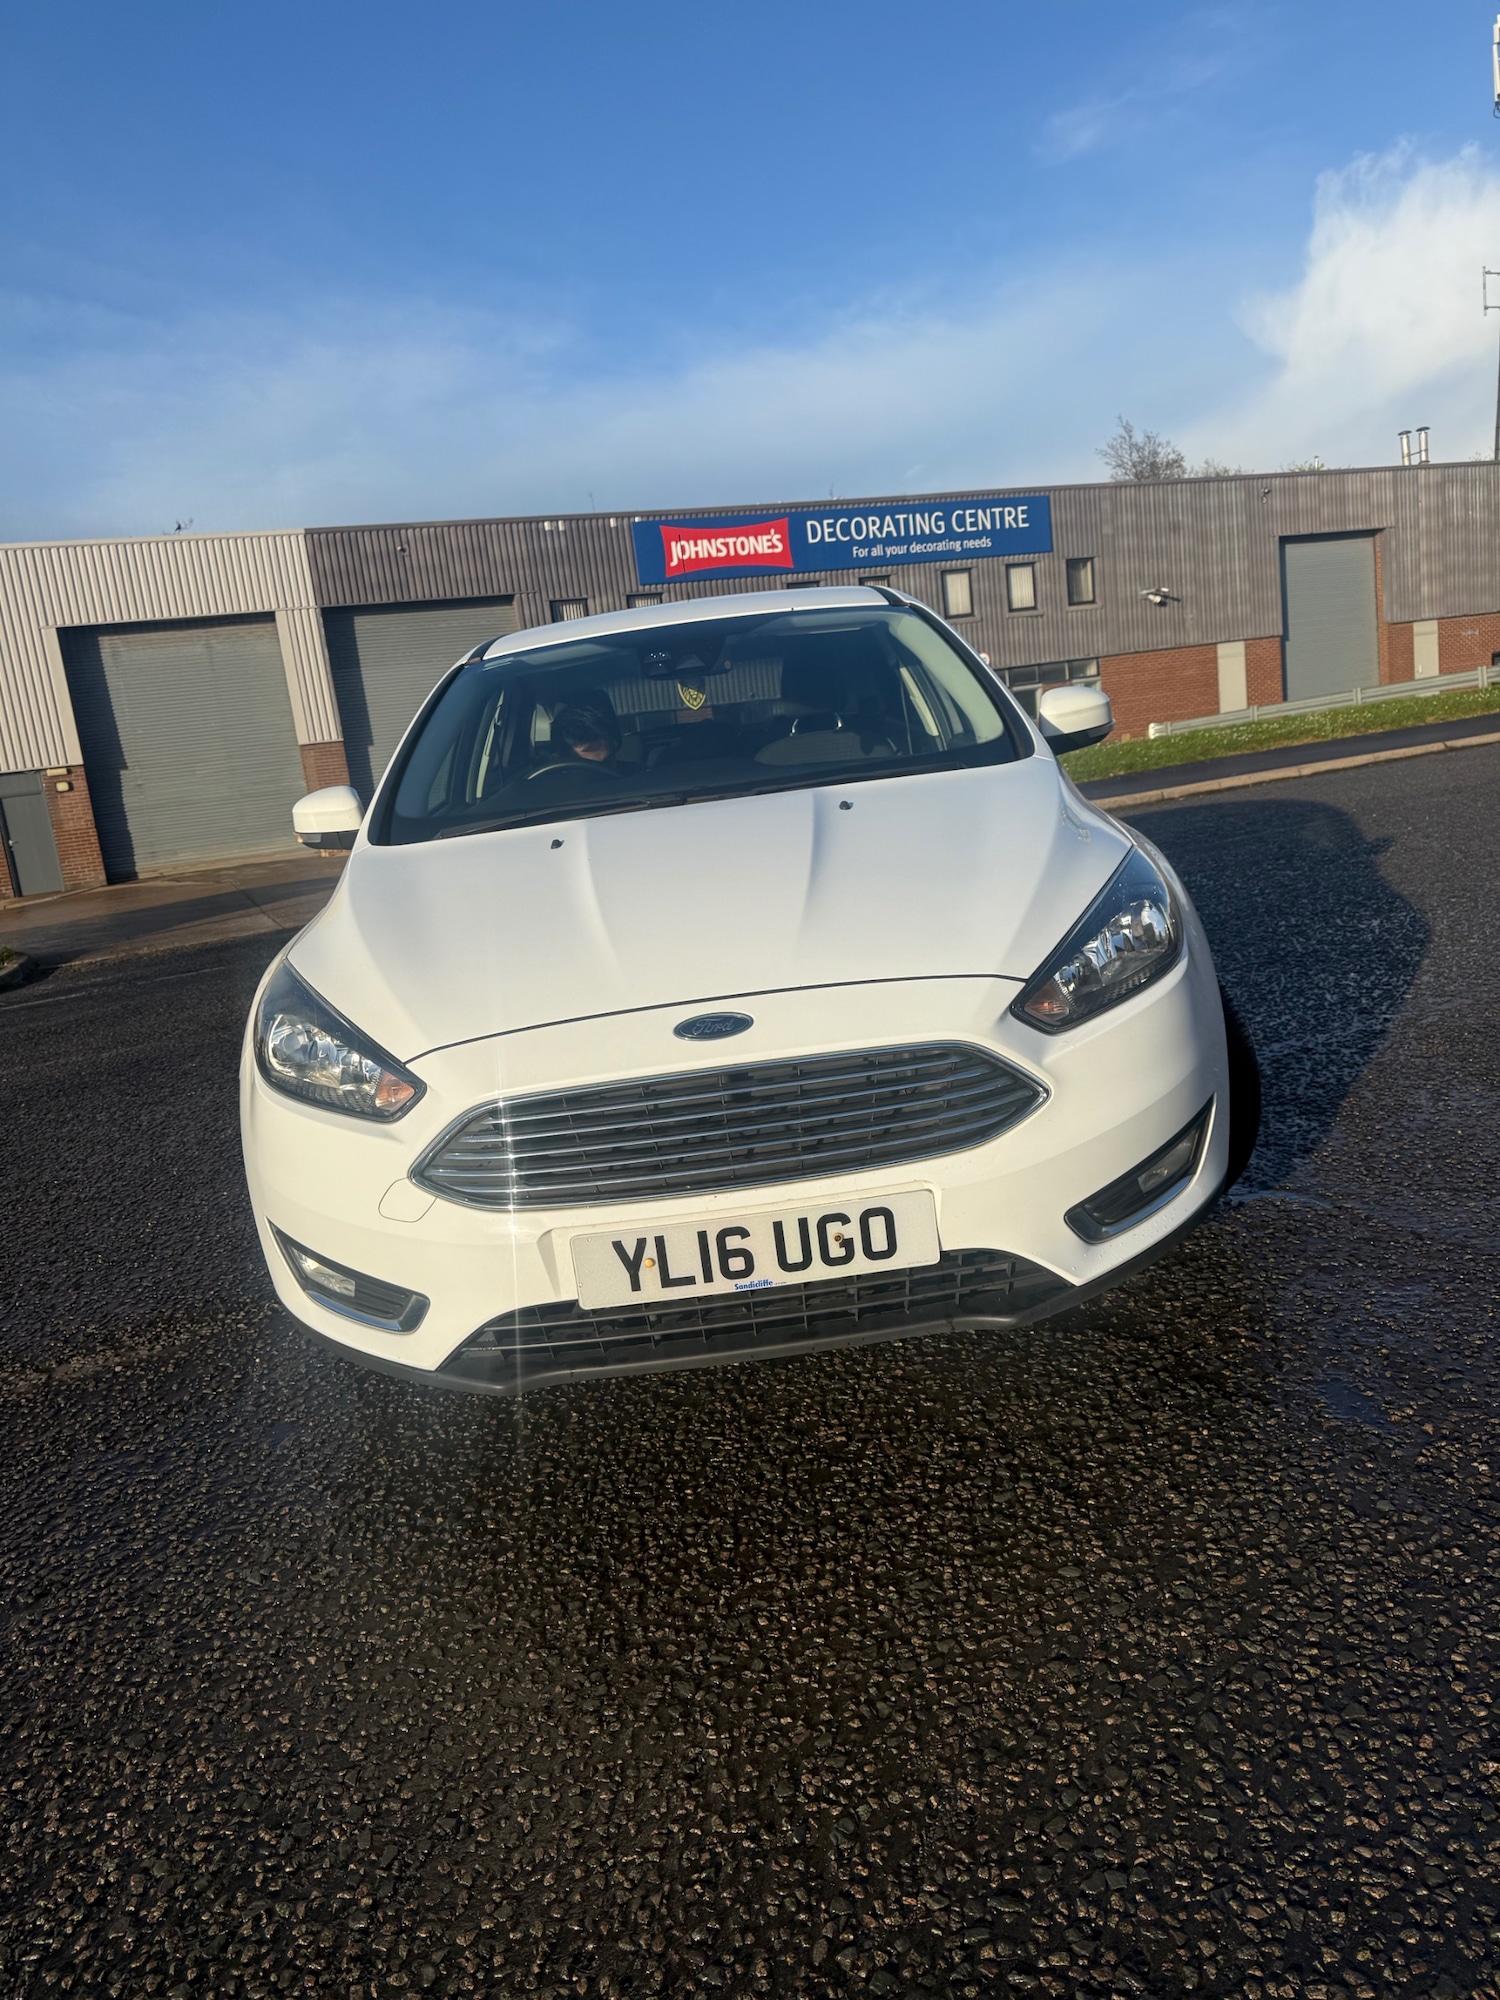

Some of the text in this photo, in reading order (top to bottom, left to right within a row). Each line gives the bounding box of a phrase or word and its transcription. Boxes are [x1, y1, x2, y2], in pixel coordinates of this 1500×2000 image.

[806, 506, 1030, 543] DECORATING CENTRE
[670, 528, 784, 567] JOHNSTONE'S
[853, 536, 992, 558] For all your decorating needs
[692, 1017, 735, 1035] Ford
[611, 1206, 897, 1292] YL16 UGO
[734, 1279, 773, 1290] Sandicliffe
